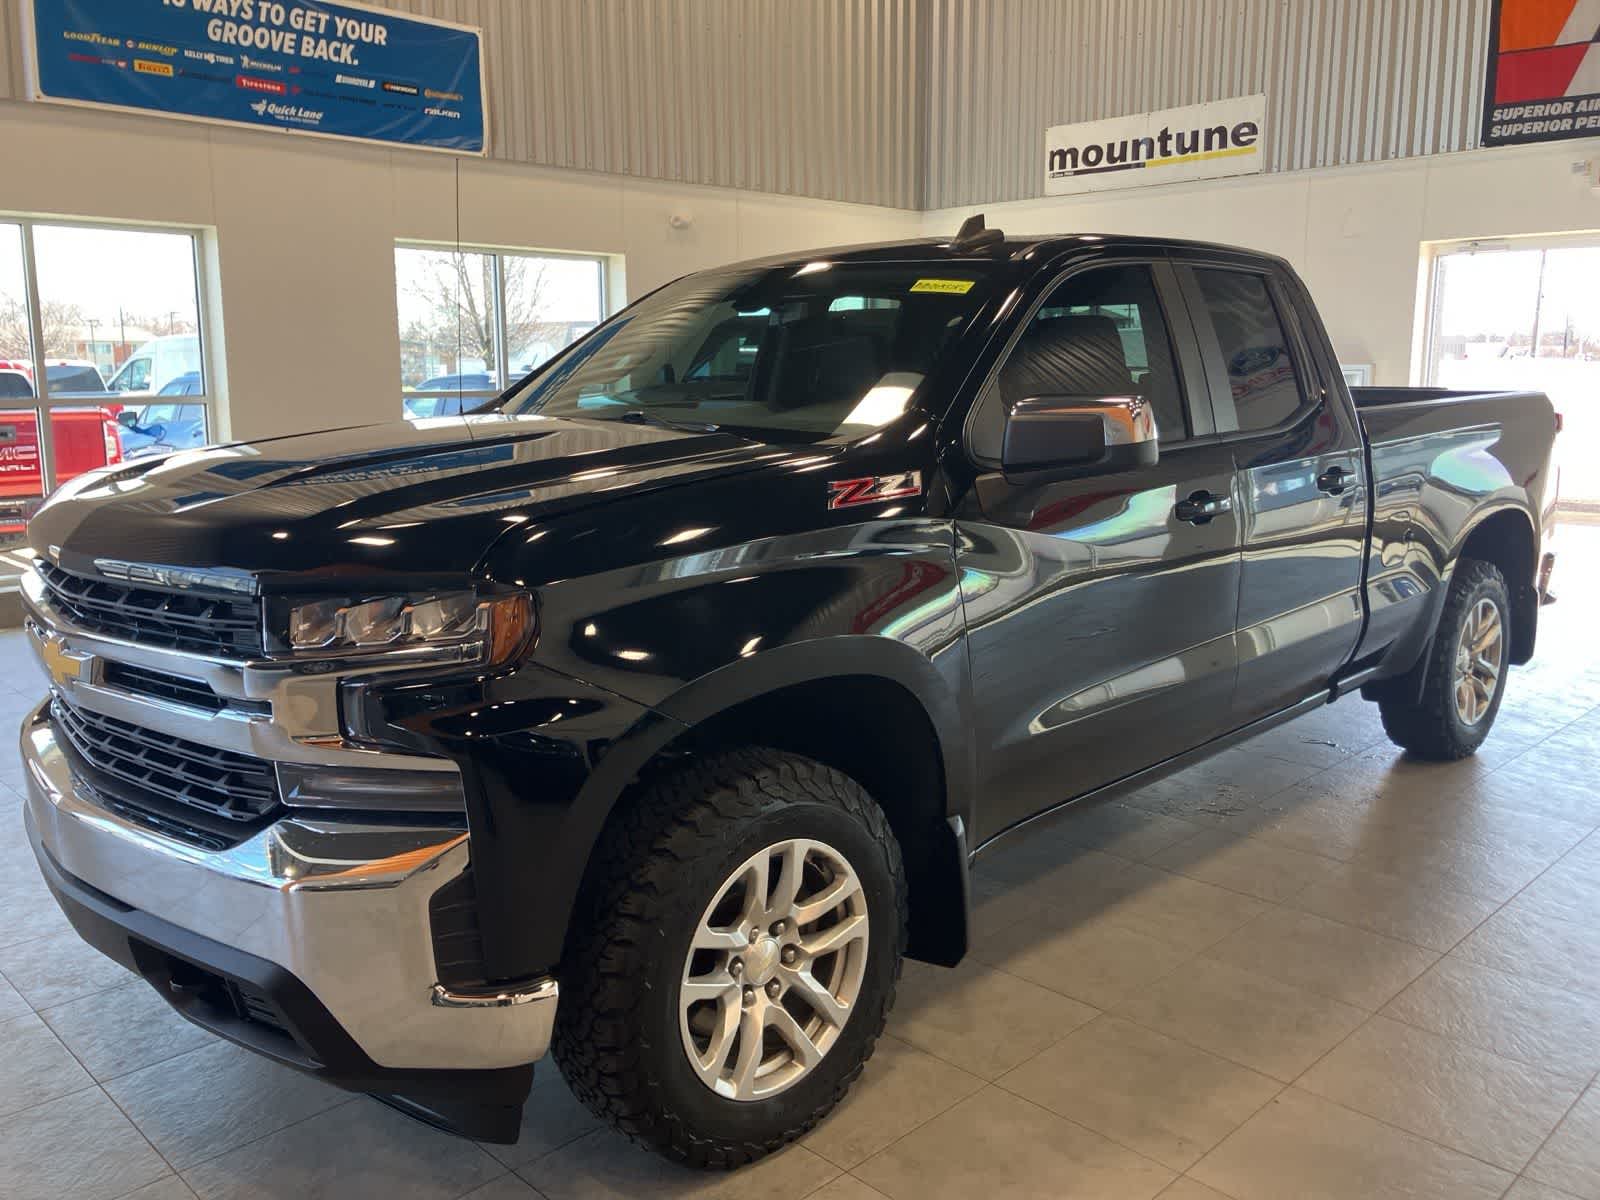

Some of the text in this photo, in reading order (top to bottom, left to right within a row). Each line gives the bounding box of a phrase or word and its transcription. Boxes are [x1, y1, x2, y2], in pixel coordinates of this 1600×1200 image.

[63, 31, 120, 46] GOODYEAR
[258, 1, 286, 26] TO
[289, 8, 330, 34] GET
[334, 16, 388, 46] YOUR
[207, 18, 360, 66] GROOVE BACK.
[267, 103, 297, 117] Quick
[1492, 101, 1575, 121] SUPERIOR
[1490, 115, 1600, 138] SUPERIOR PE
[1048, 121, 1259, 173] mountune
[827, 470, 922, 510] Z71
